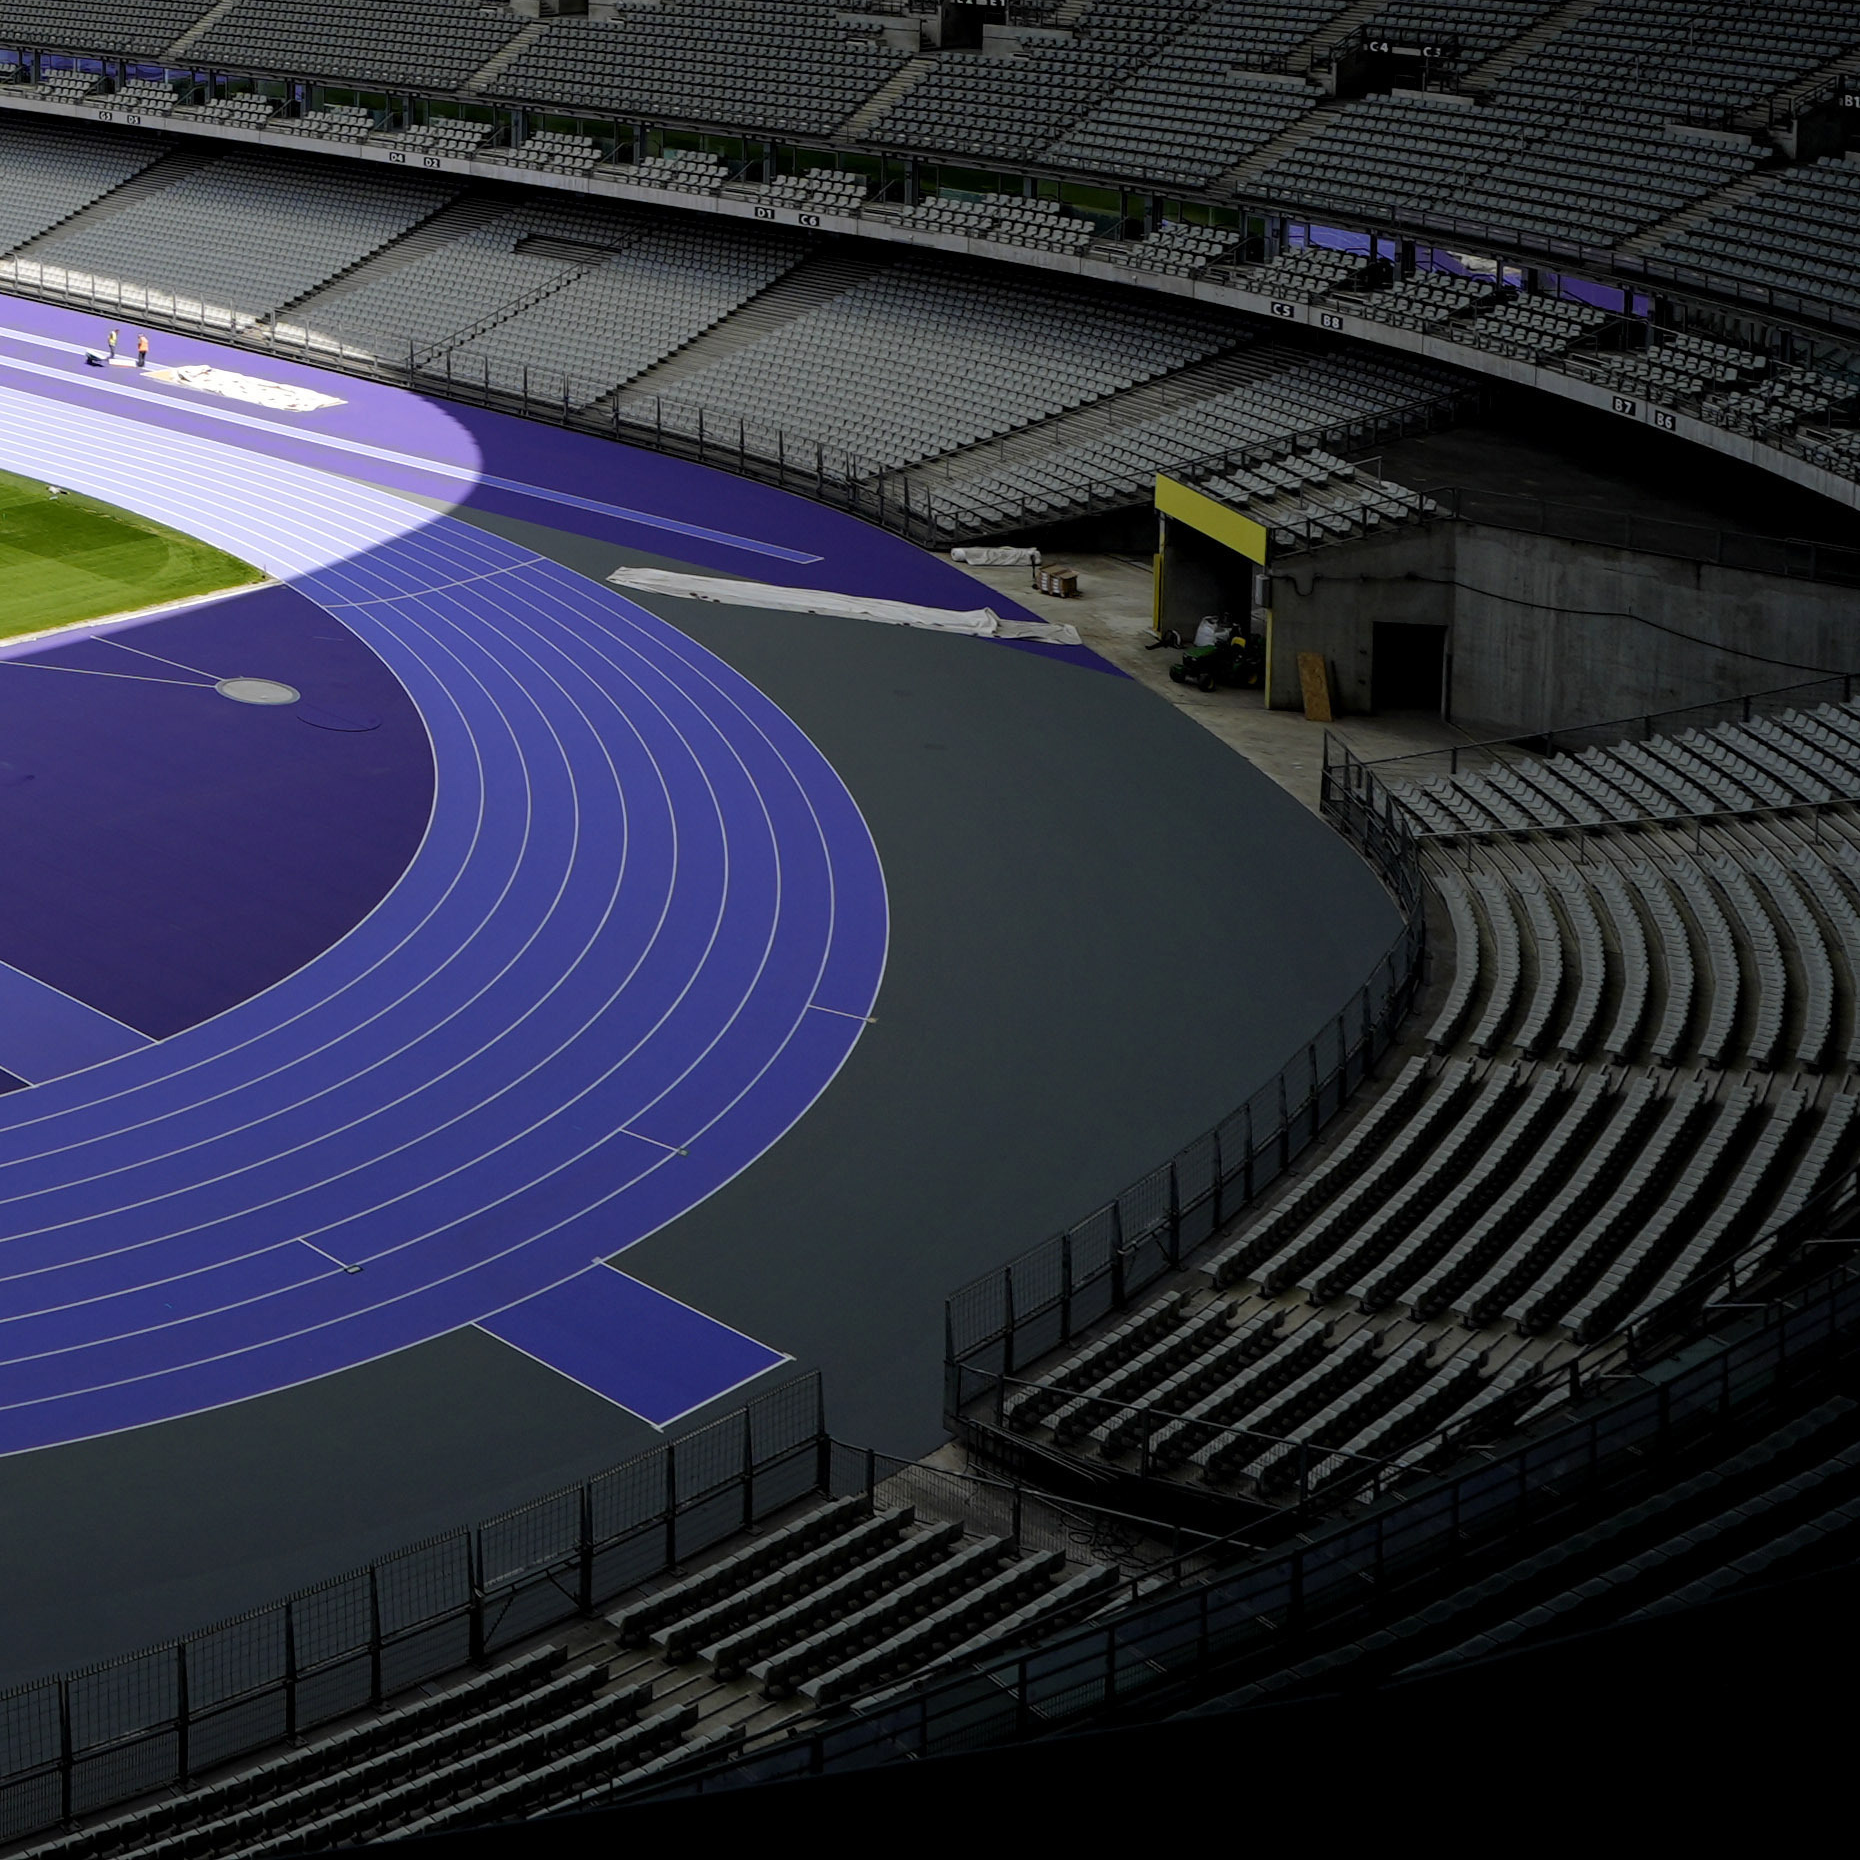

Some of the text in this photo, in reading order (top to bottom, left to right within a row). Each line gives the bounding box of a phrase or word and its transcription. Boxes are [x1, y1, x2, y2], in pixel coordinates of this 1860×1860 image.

[1369, 41, 1389, 53] C4
[425, 158, 438, 168] D2
[757, 207, 817, 225] D1 C6
[1273, 303, 1340, 329] C5 B8
[1614, 398, 1673, 428] B7 B6
